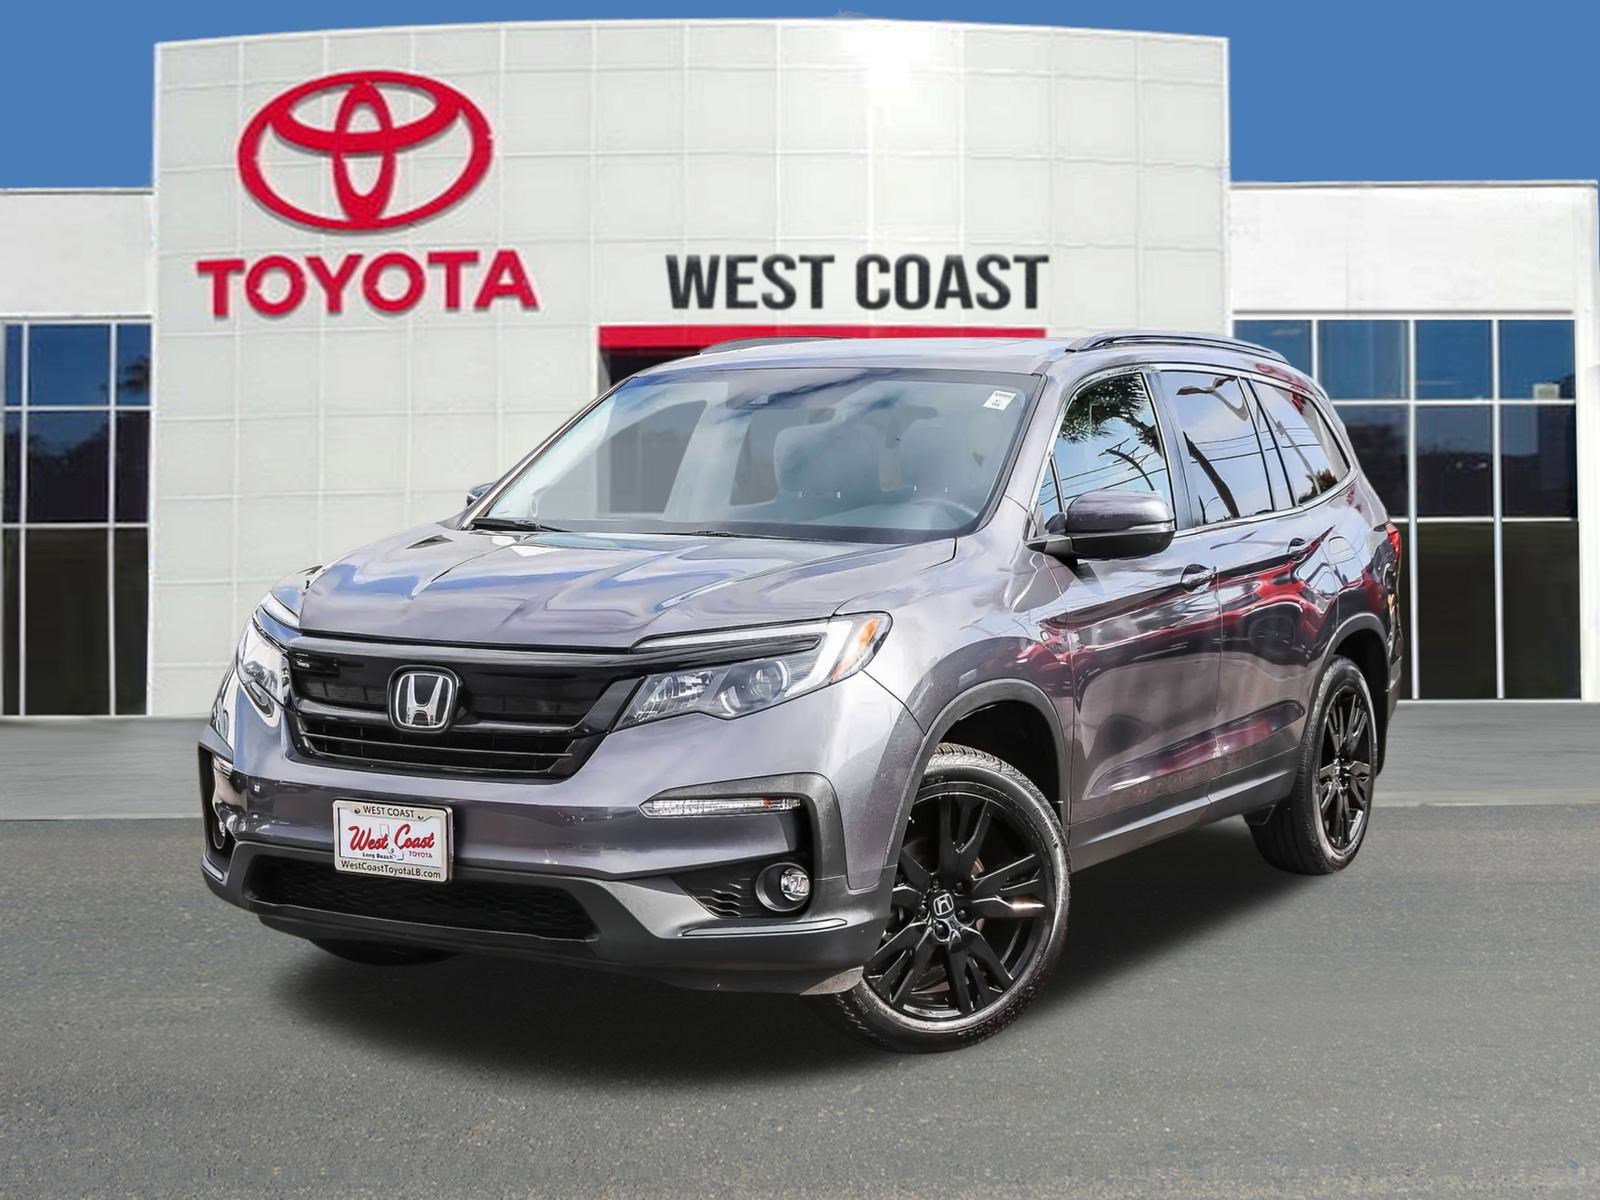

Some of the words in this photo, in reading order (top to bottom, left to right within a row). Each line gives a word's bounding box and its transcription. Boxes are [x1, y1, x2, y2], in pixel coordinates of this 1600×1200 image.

[196, 249, 540, 318] TOYOTA
[665, 254, 836, 309] WEST
[855, 253, 1050, 310] COAST
[362, 805, 385, 816] WEST
[387, 807, 415, 818] COAST
[348, 825, 389, 851] West
[394, 823, 435, 850] Coast
[362, 851, 376, 859] Long
[409, 850, 433, 859] TOYOTA
[341, 860, 440, 879] WestCoastToyotaLB.com
